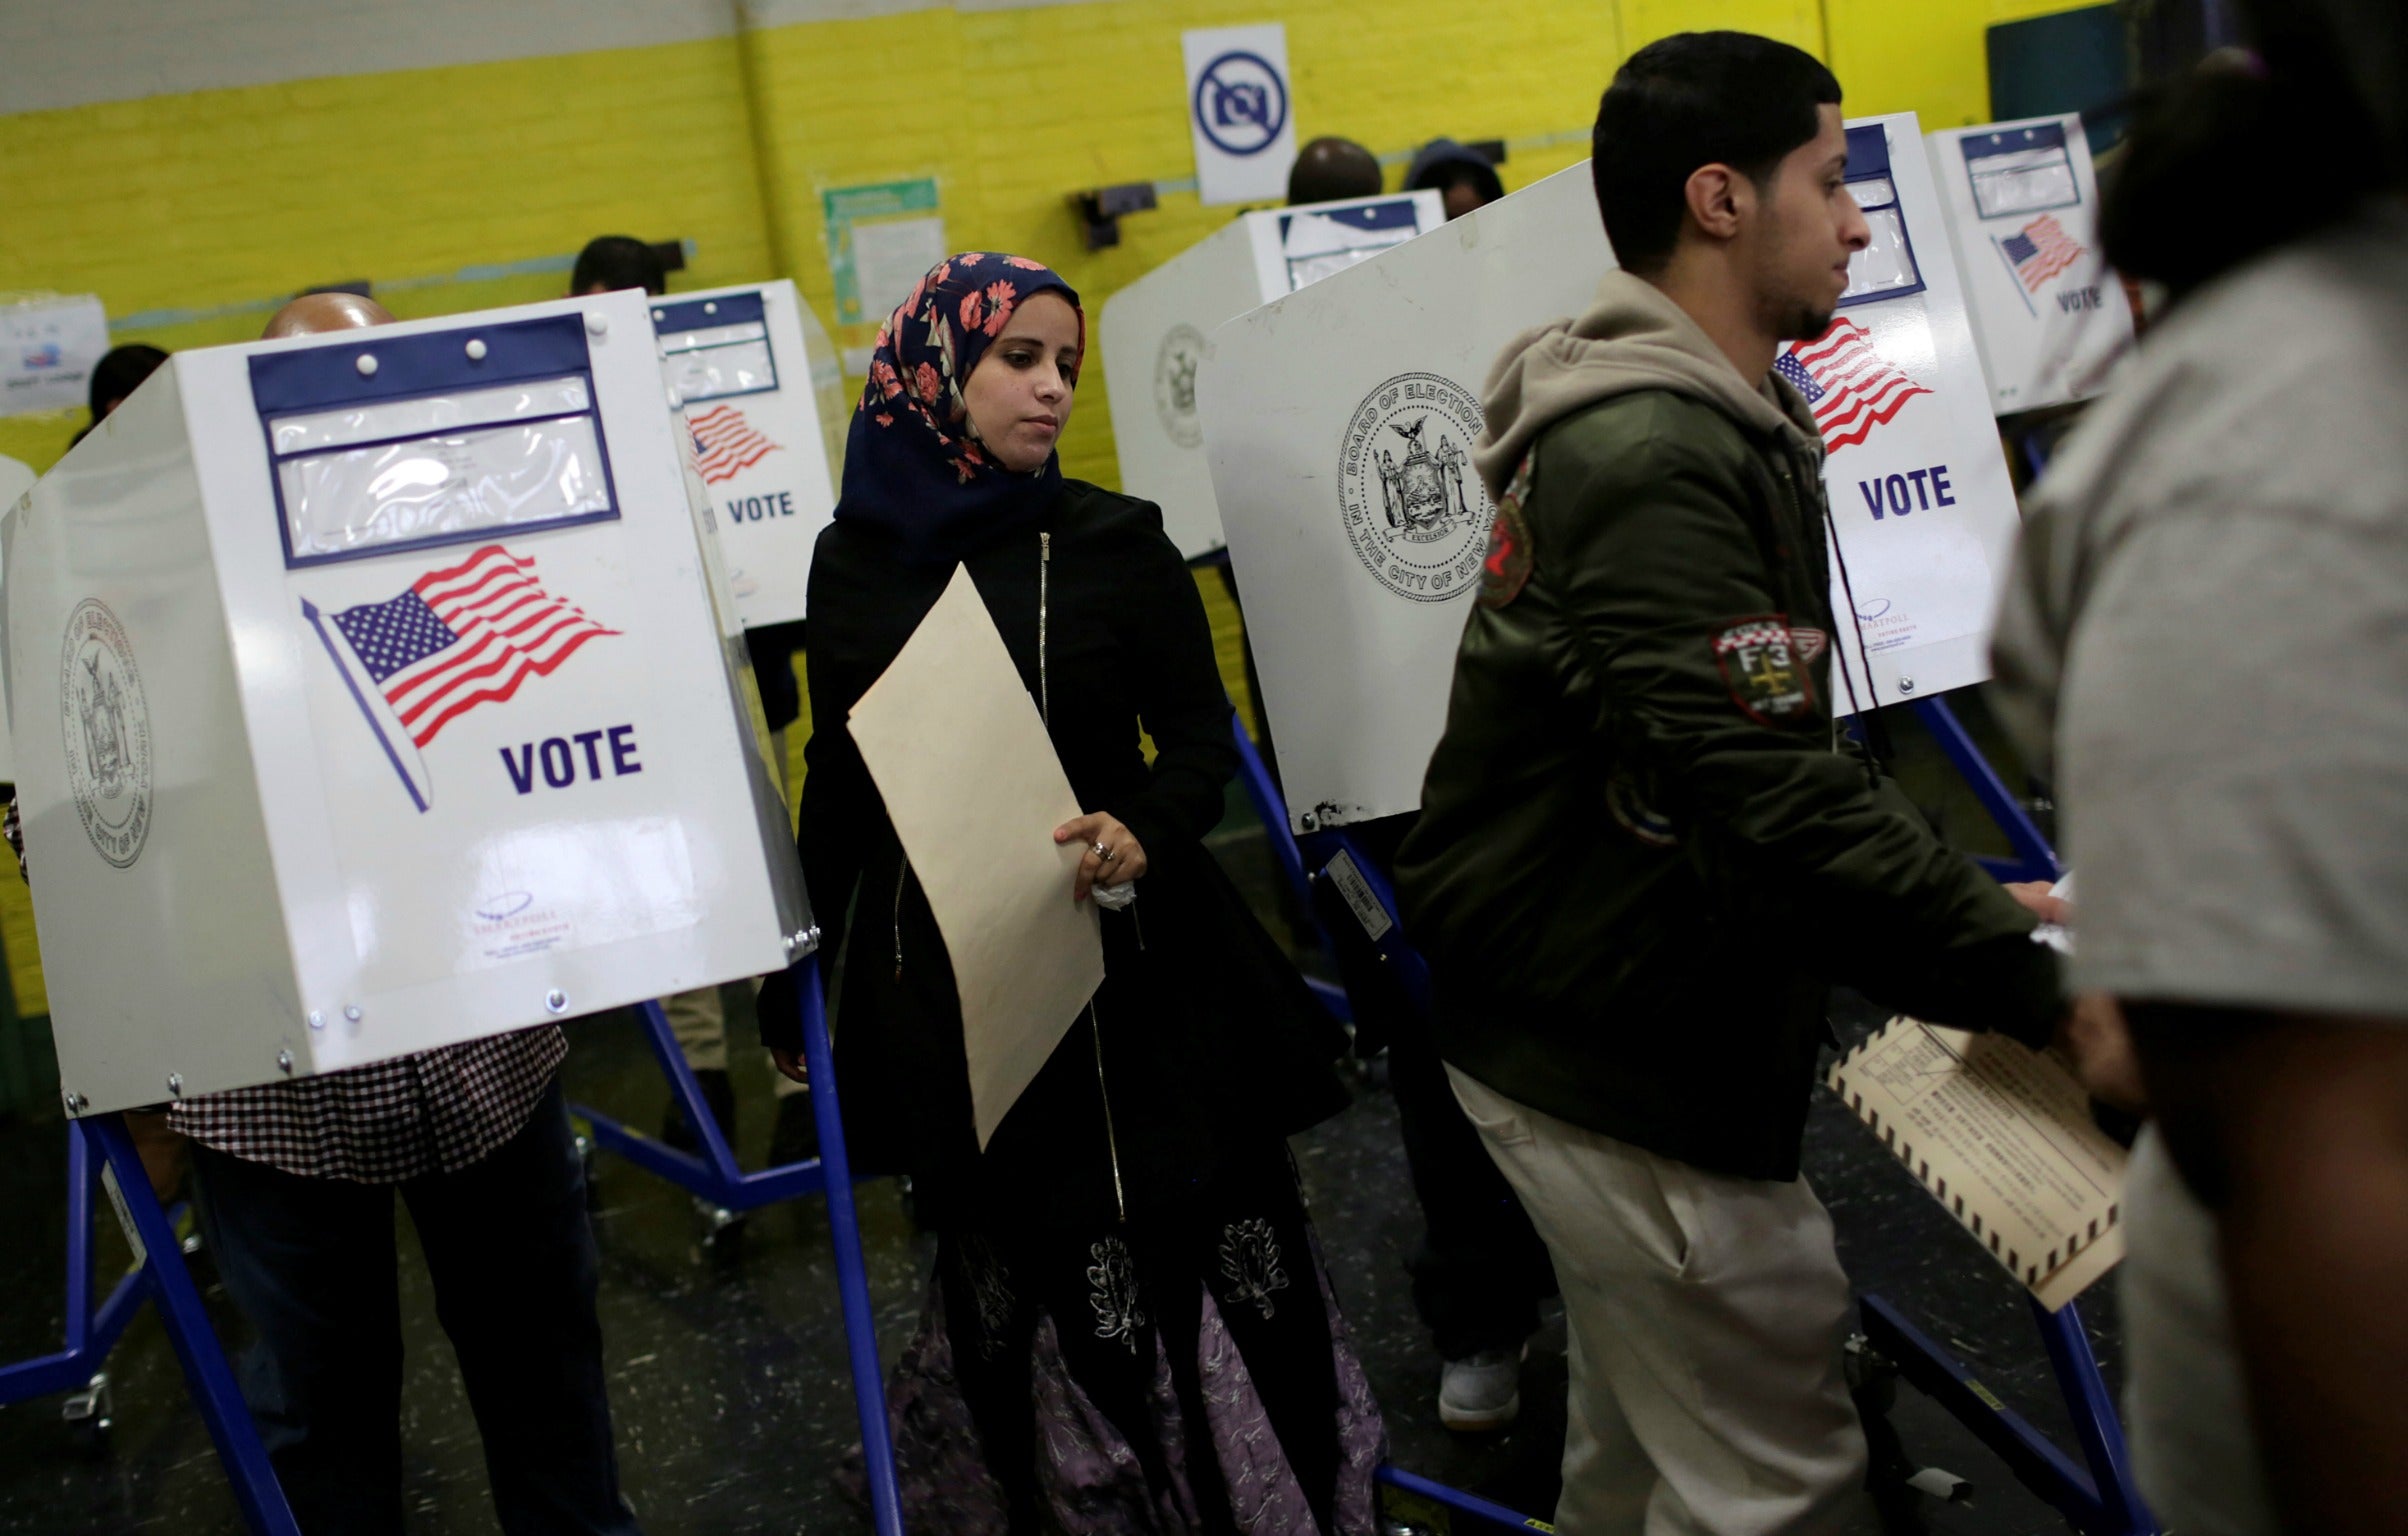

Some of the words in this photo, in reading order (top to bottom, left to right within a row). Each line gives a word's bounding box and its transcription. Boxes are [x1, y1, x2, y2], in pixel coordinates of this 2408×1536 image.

[2056, 284, 2103, 314] VOTE
[1346, 407, 1378, 477] BOARD
[1379, 387, 1400, 410] OF
[1404, 383, 1484, 436] ELECTION
[727, 491, 794, 523] VOTE
[1858, 464, 1956, 521] VOTE
[1349, 503, 1363, 526] IN
[1359, 528, 1387, 568] THE
[1388, 564, 1428, 590] CITY
[1431, 570, 1453, 590] OF
[1454, 537, 1490, 580] NEW
[1411, 528, 1450, 542] EXCELSIOR
[498, 723, 643, 795] VOTE
